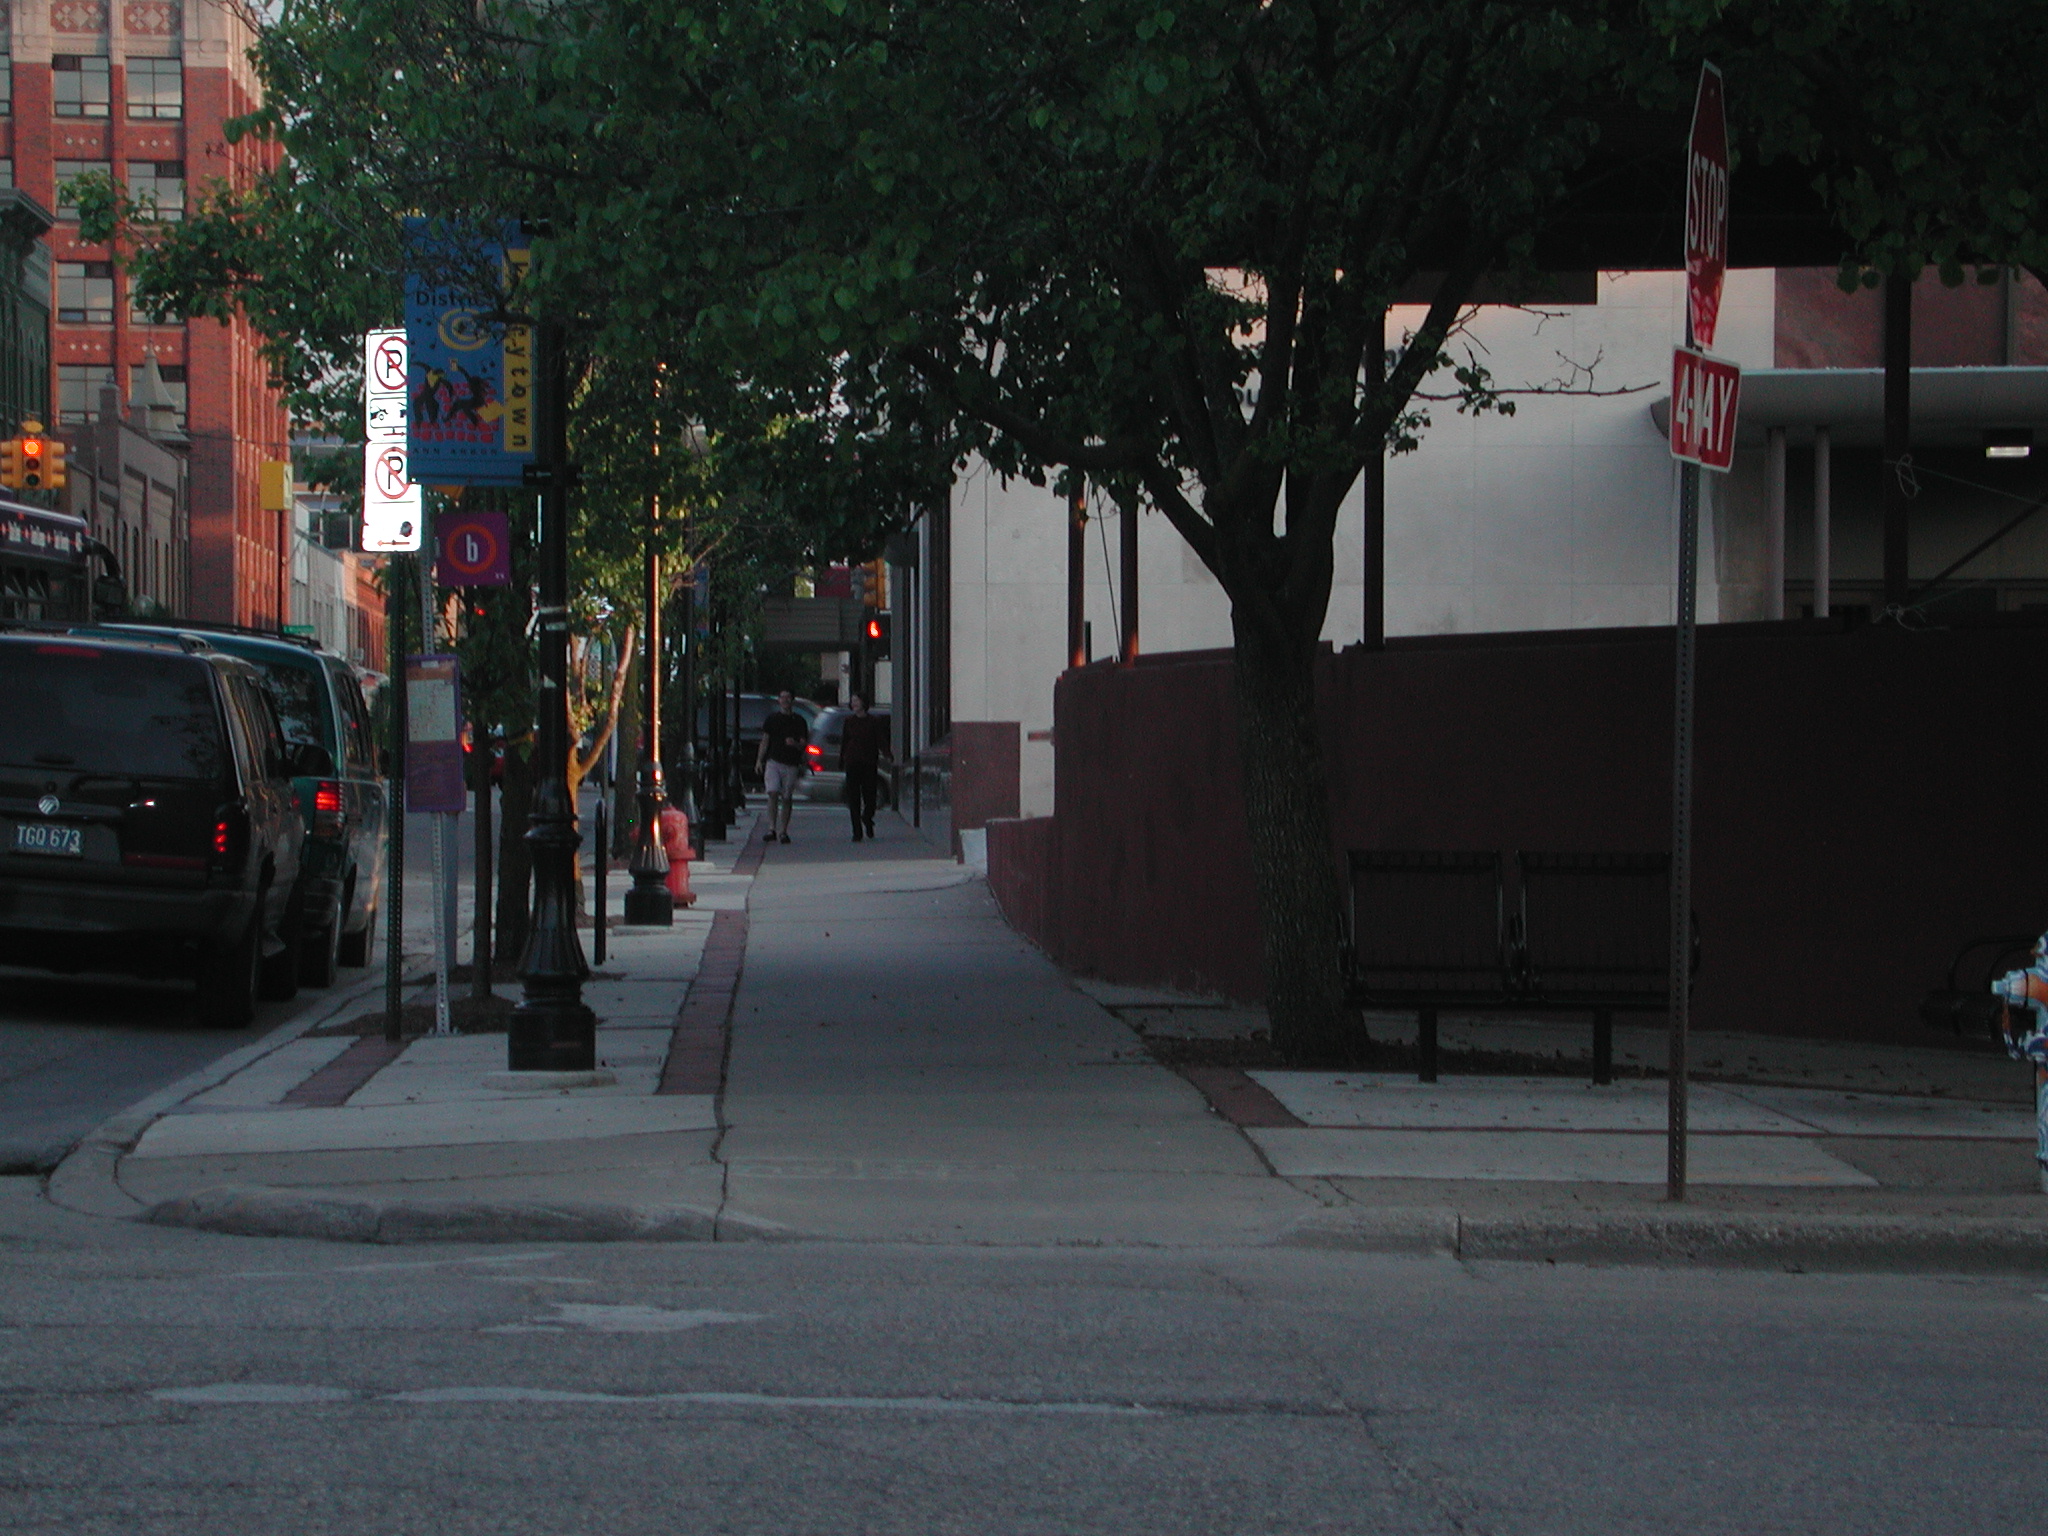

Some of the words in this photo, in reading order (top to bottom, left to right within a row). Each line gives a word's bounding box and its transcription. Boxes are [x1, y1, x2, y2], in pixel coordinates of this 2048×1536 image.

[1689, 150, 1726, 262] STOP
[1675, 363, 1735, 453] 4-WAY
[466, 533, 479, 562] b
[50, 829, 81, 848] 673
